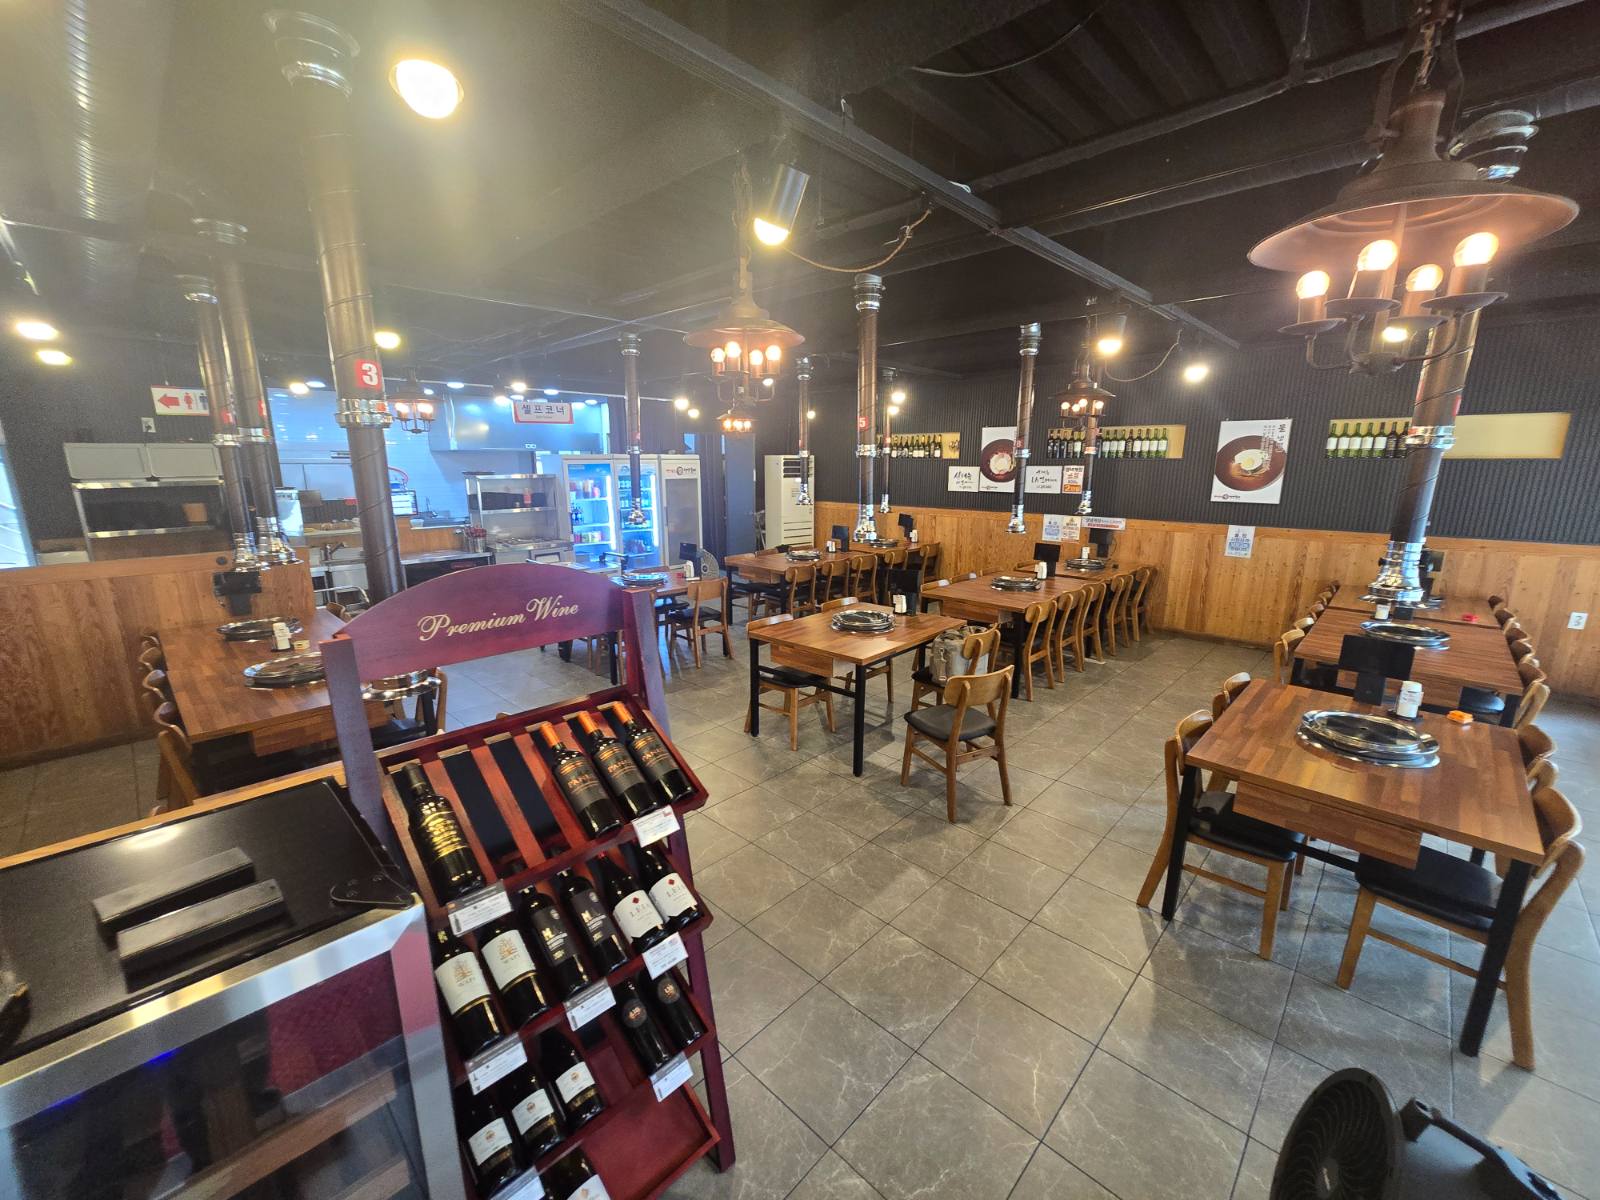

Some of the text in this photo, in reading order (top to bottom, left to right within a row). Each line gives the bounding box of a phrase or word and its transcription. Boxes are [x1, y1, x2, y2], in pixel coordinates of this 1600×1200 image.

[361, 363, 378, 386] 3
[859, 417, 866, 428] 5
[417, 595, 579, 641] Premium Wine
